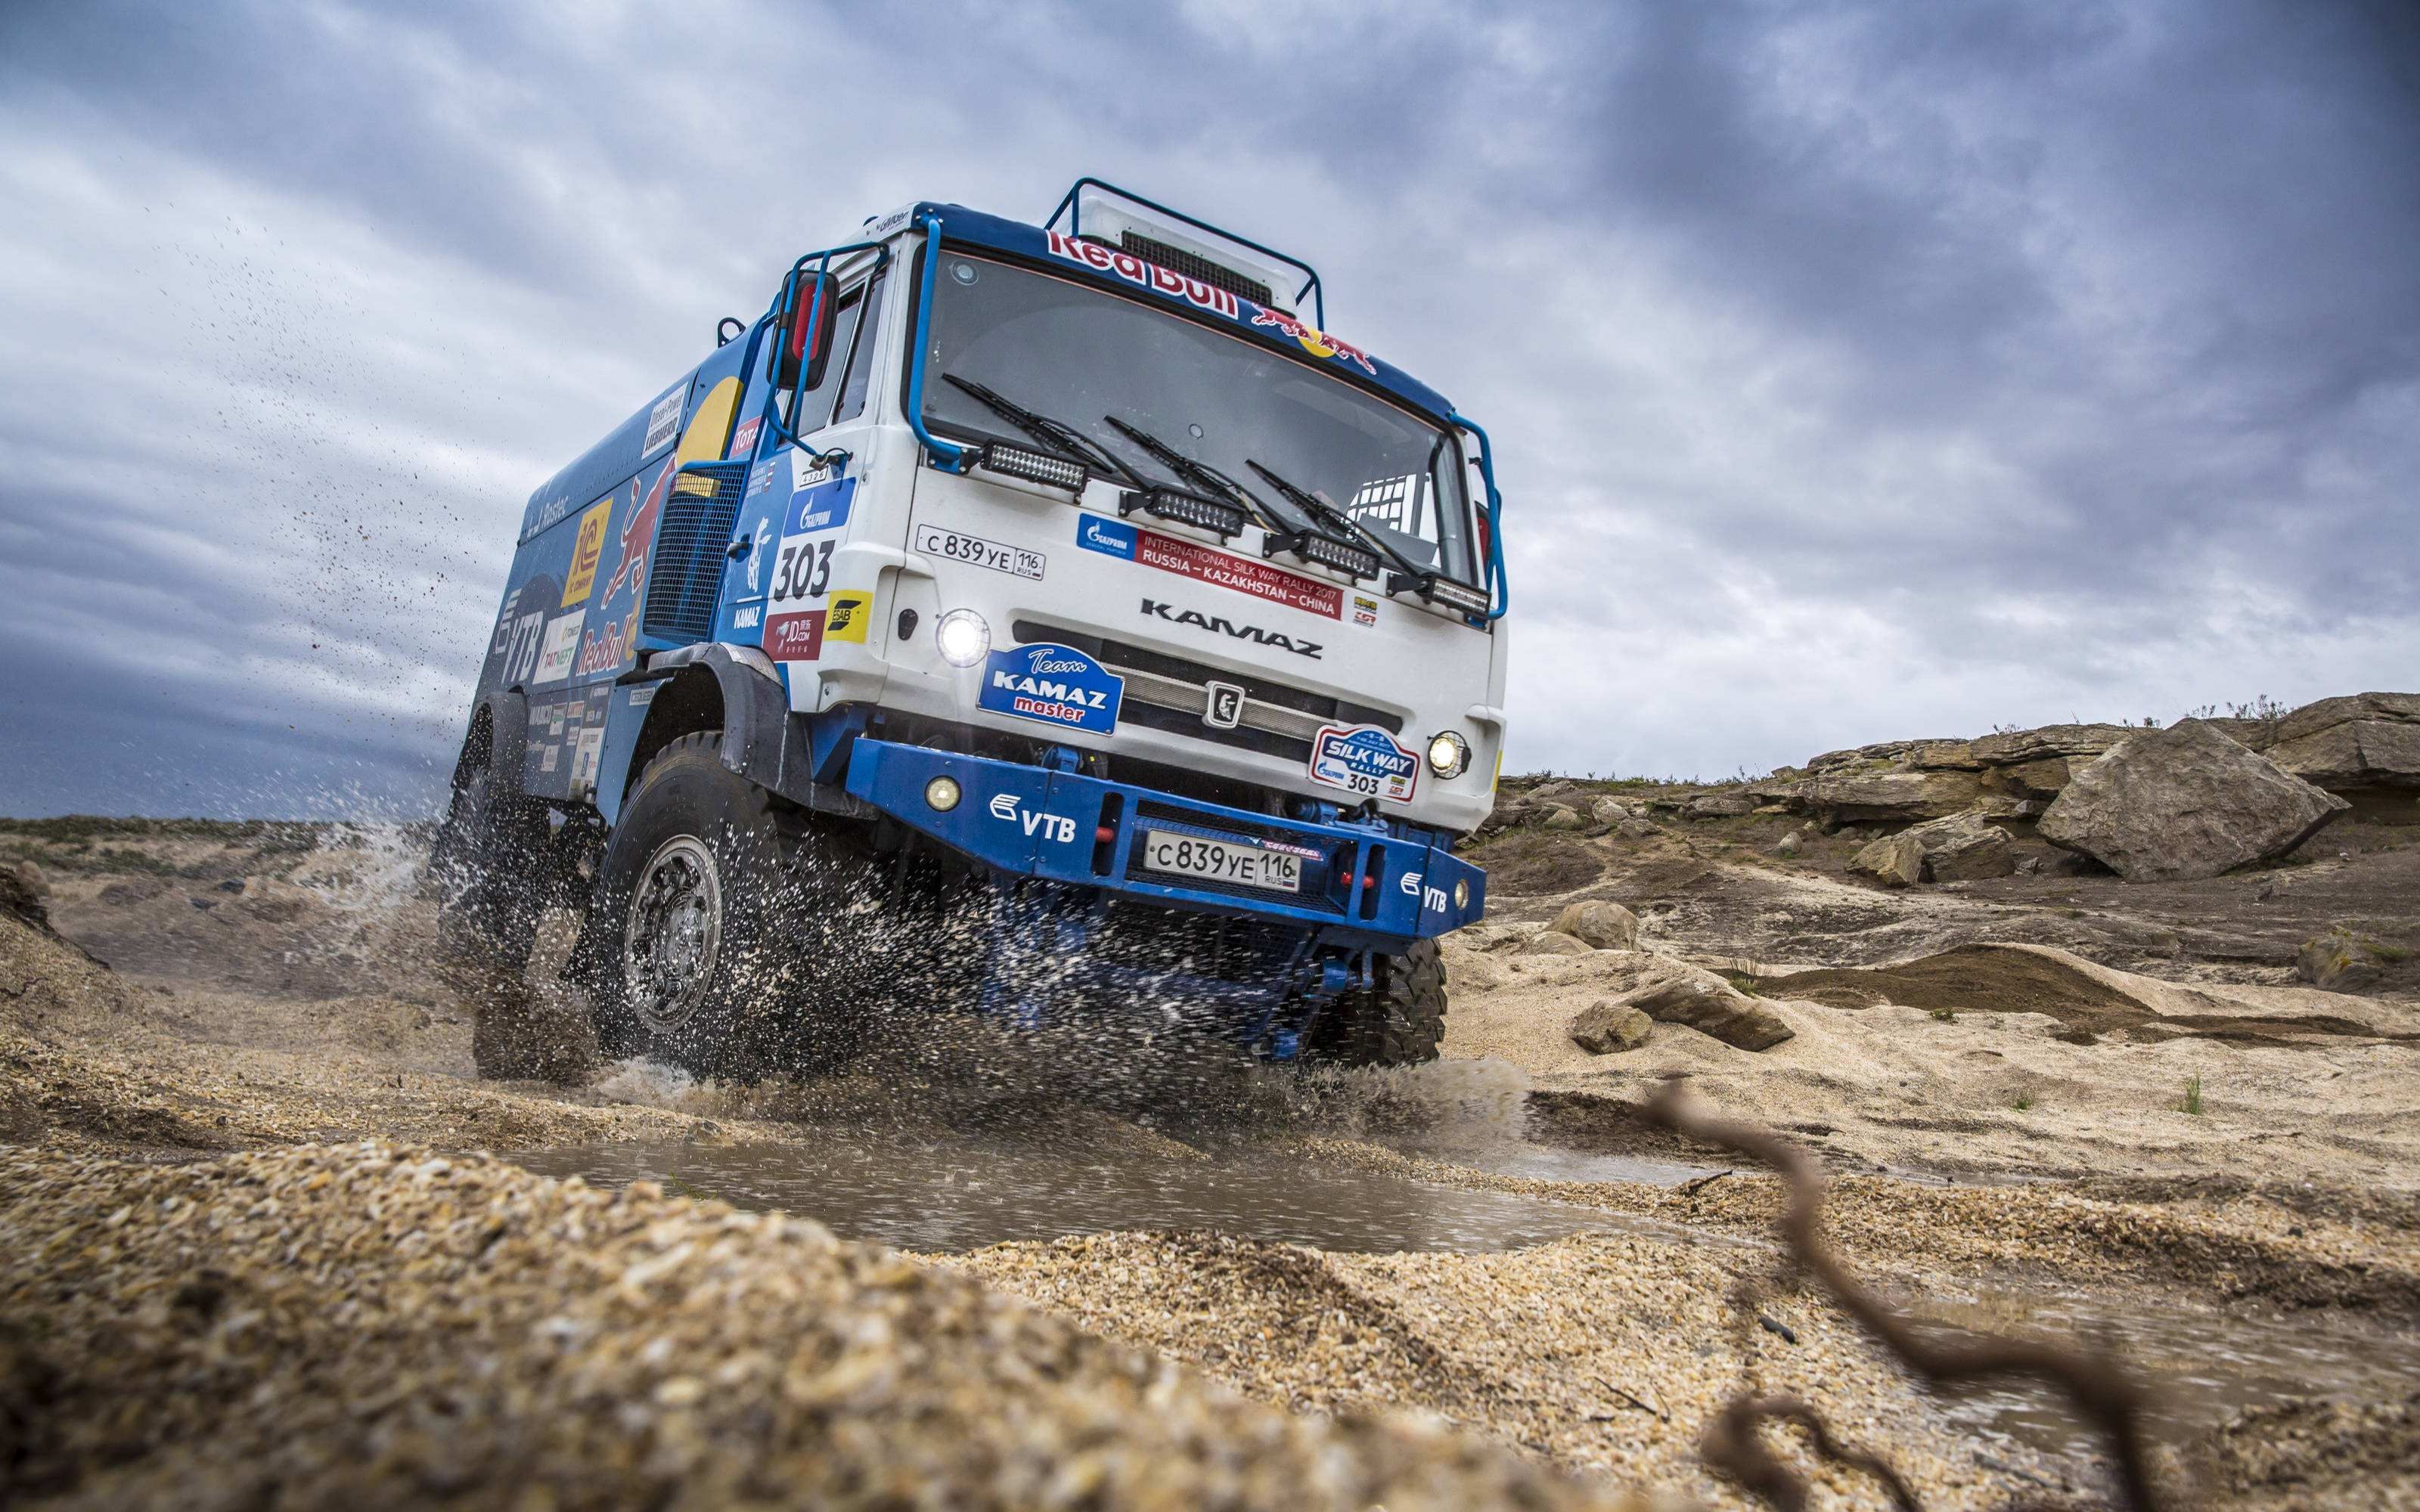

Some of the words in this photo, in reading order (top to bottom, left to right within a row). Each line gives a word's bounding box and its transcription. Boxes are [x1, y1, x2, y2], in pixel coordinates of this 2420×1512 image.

[1049, 231, 1145, 283] Red
[1151, 264, 1238, 318] Bull
[645, 416, 678, 451] LIEBHERR
[735, 425, 759, 451] TOTA
[803, 472, 824, 482] 4326
[773, 539, 836, 603] 303
[1016, 566, 1032, 576] RUS
[1018, 553, 1039, 569] 116
[1144, 535, 1230, 569] INTERNATIONAL
[1233, 561, 1255, 577] SILK
[1258, 568, 1280, 584] WAY
[1283, 576, 1314, 593] RALLY
[1316, 586, 1336, 600] 2017
[1143, 550, 1190, 572] RUSSIA
[1203, 568, 1288, 600] KAZAKHSTAN
[1298, 594, 1335, 615] CHINA
[734, 606, 761, 630] KAMAZ
[833, 609, 852, 621] ESAB
[1140, 597, 1323, 660] KAMAZ
[501, 611, 544, 683] VTB
[544, 646, 575, 669] TATNEFT
[1028, 649, 1087, 673] Team
[992, 671, 1108, 709] KAMAZ
[1013, 696, 1085, 723] master
[1326, 740, 1373, 764] SILK
[1373, 751, 1412, 773] WAY
[1350, 762, 1385, 775] RALLY
[1347, 773, 1379, 795] 303
[1022, 810, 1077, 844] VTB
[1260, 853, 1292, 878] 116
[1264, 875, 1283, 886] RUS
[1423, 885, 1447, 913] VTB
